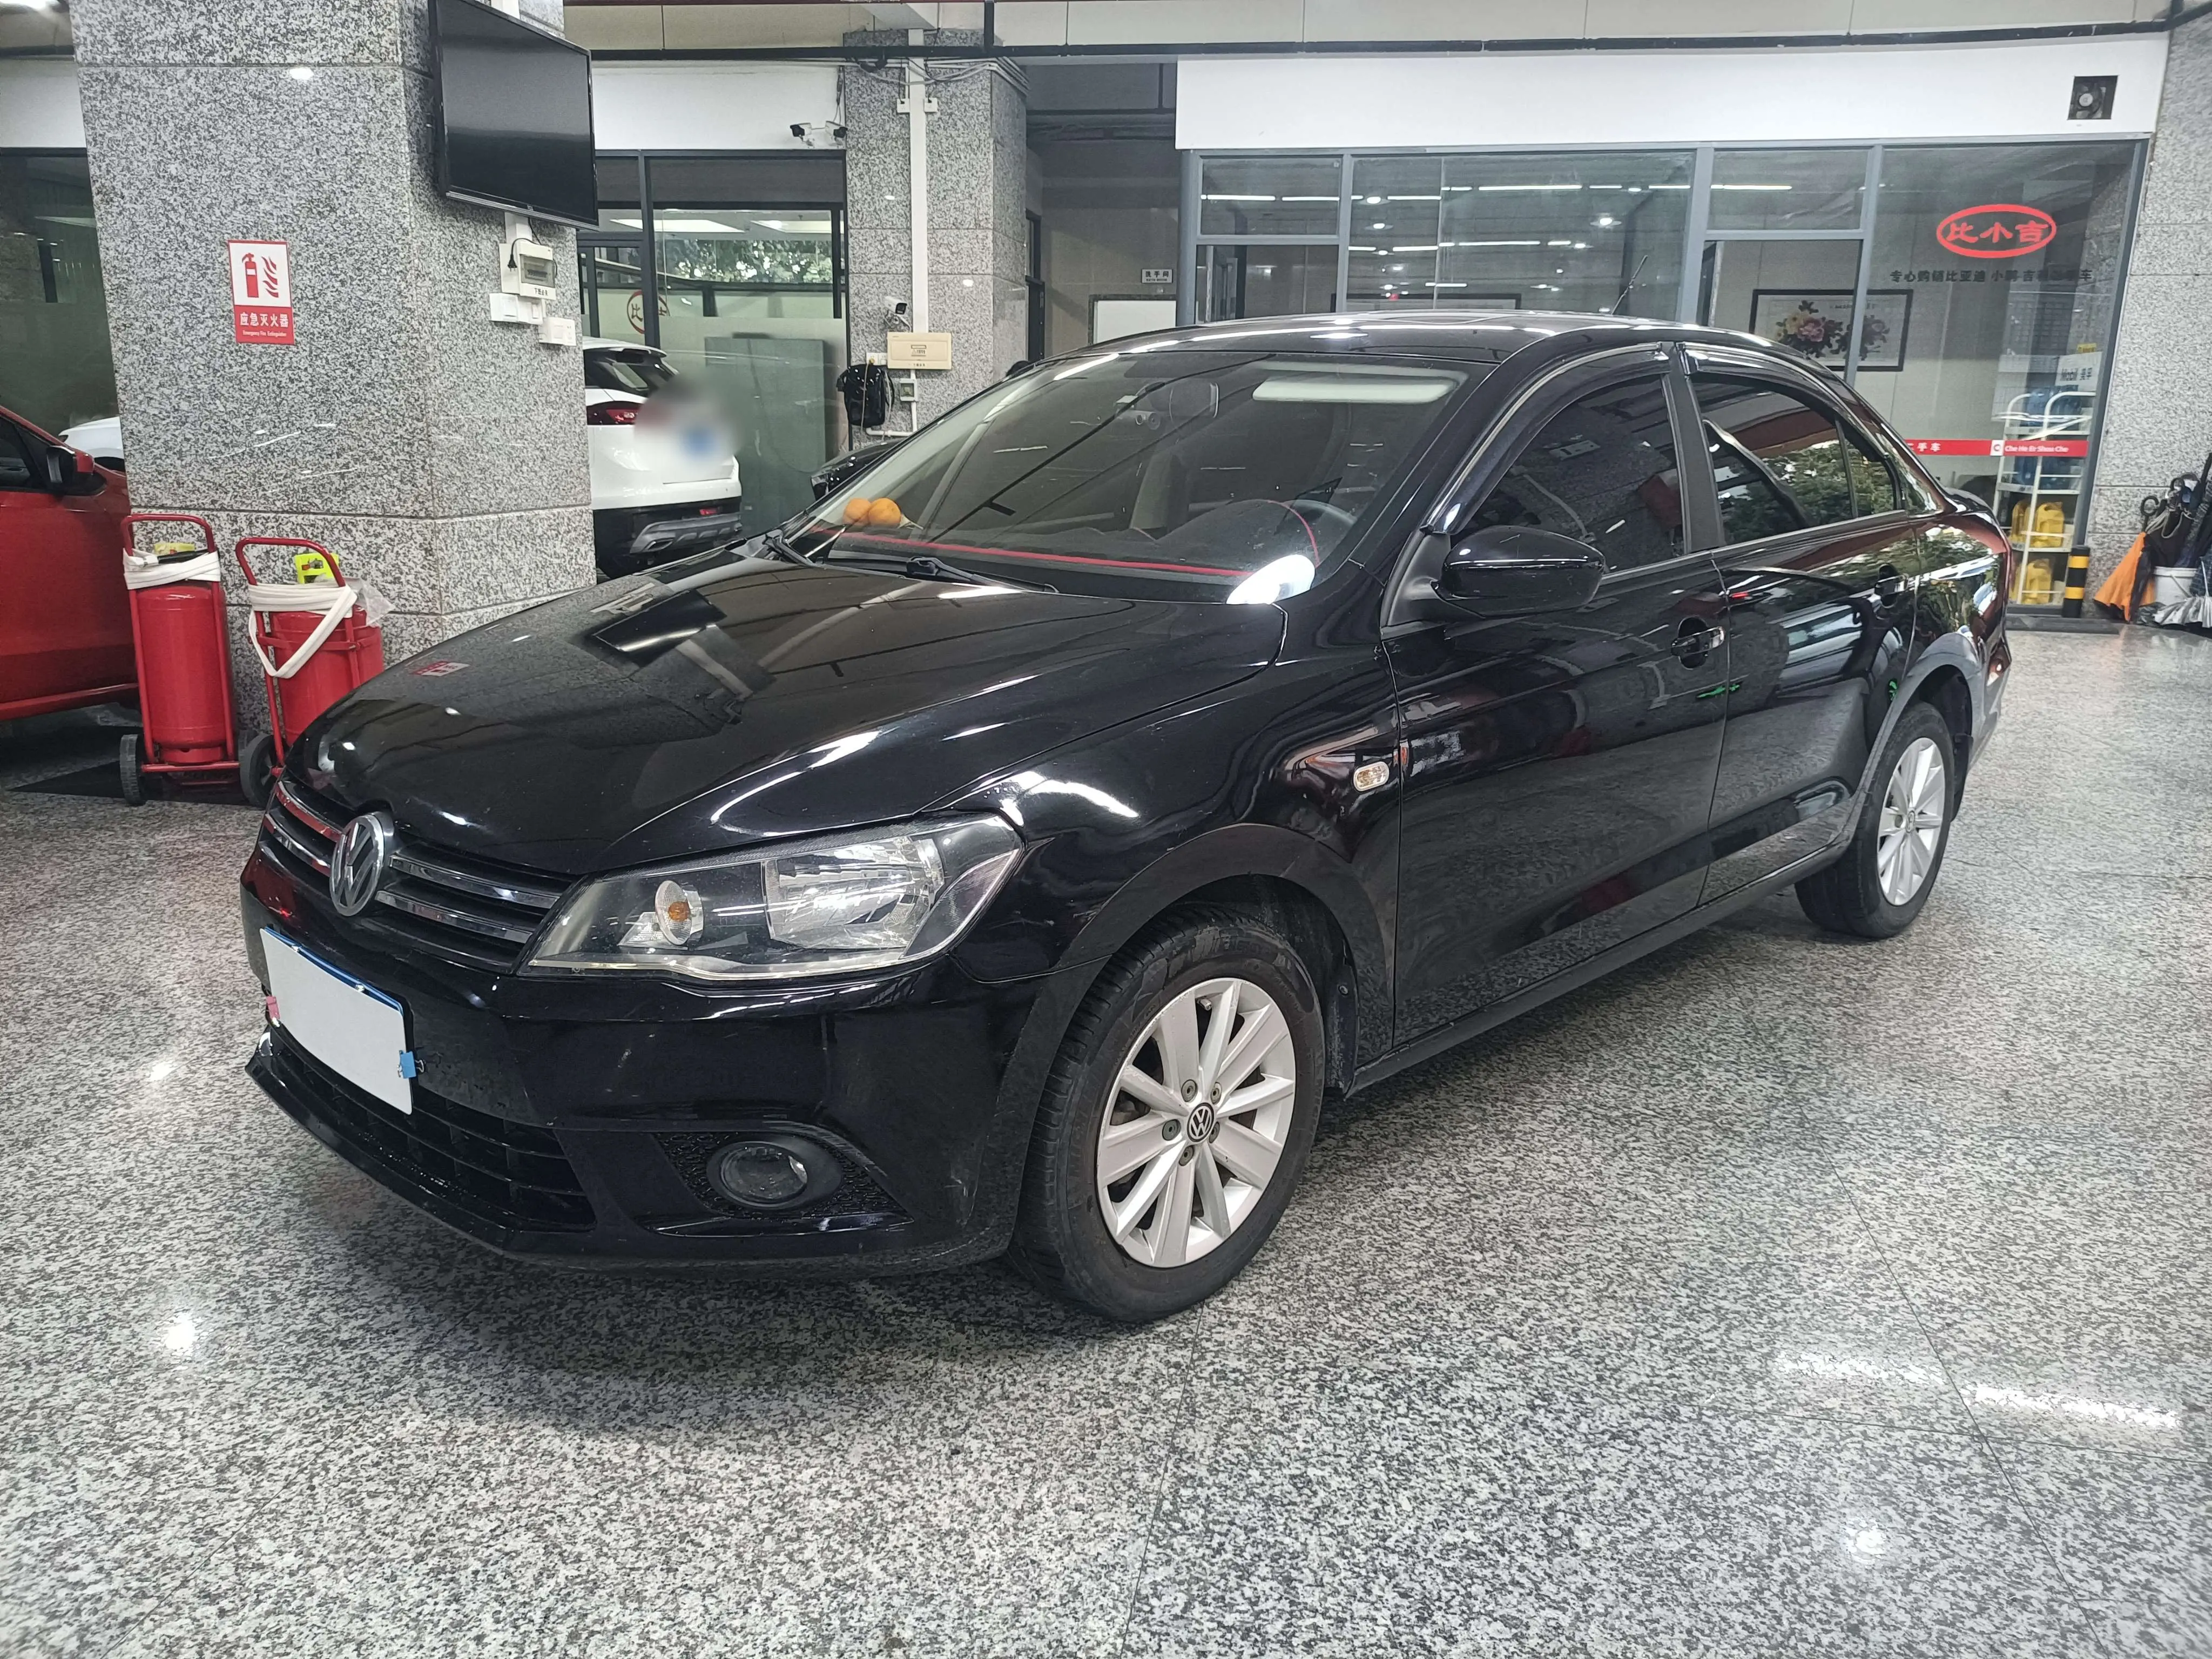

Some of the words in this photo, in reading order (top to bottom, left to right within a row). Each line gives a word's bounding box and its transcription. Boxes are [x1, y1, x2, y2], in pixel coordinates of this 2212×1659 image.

[1946, 220, 2049, 243] 比小吉
[240, 312, 289, 328] 应急灭火器
